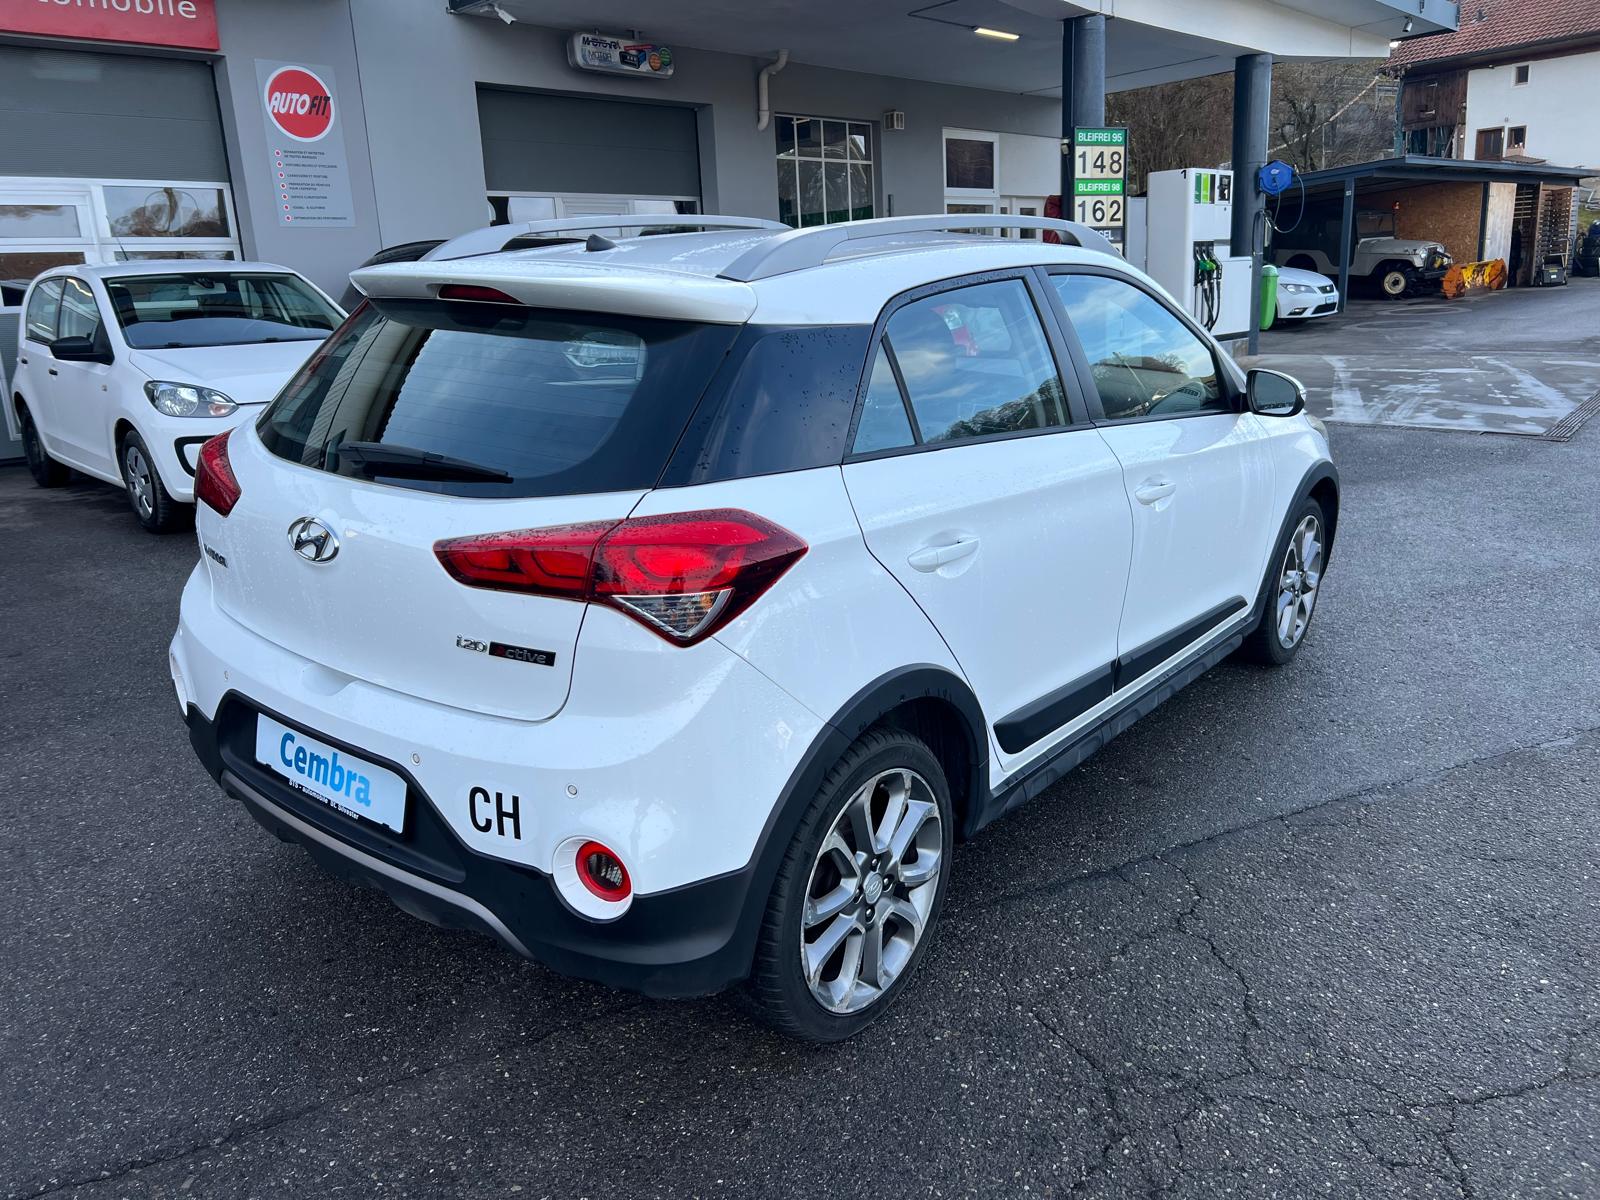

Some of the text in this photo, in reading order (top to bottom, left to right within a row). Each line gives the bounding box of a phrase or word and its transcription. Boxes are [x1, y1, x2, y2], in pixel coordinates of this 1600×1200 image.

[38, 0, 197, 19] obile
[1078, 132, 1123, 142] BLEIFREI 95
[1078, 151, 1122, 175] 148
[1180, 169, 1188, 180] 1
[1078, 183, 1121, 191] BLEIFREI 98
[1077, 199, 1122, 223] 162
[280, 732, 371, 807] Cembra
[469, 786, 521, 840] CH
